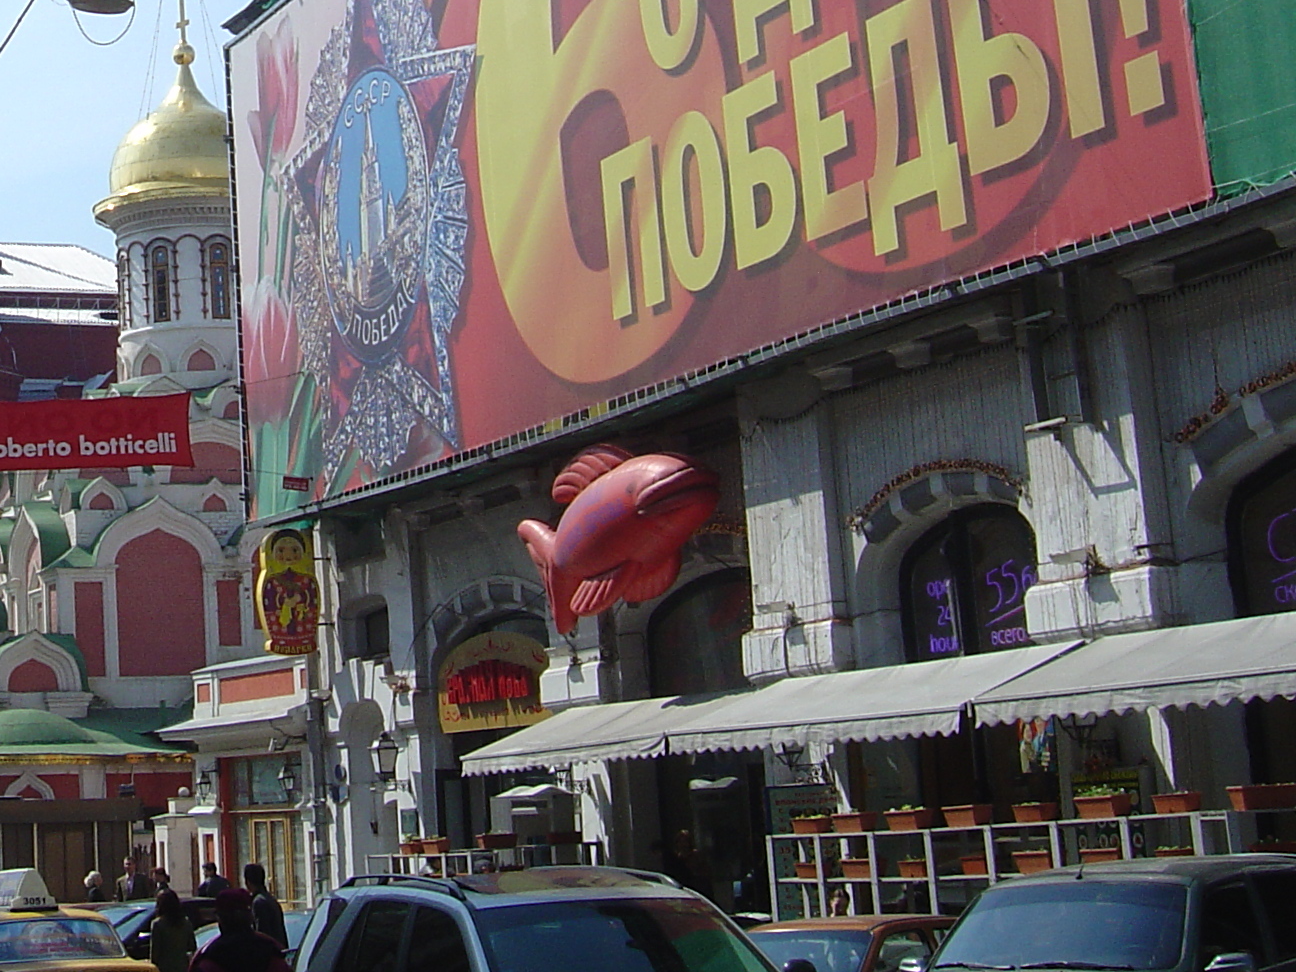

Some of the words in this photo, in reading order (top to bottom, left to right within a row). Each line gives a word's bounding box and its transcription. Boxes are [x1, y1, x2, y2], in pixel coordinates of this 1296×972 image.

[344, 78, 392, 127] СССР
[352, 292, 408, 345] ПОБЕДА
[79, 432, 177, 457] botticelli
[22, 896, 47, 906] 3051
